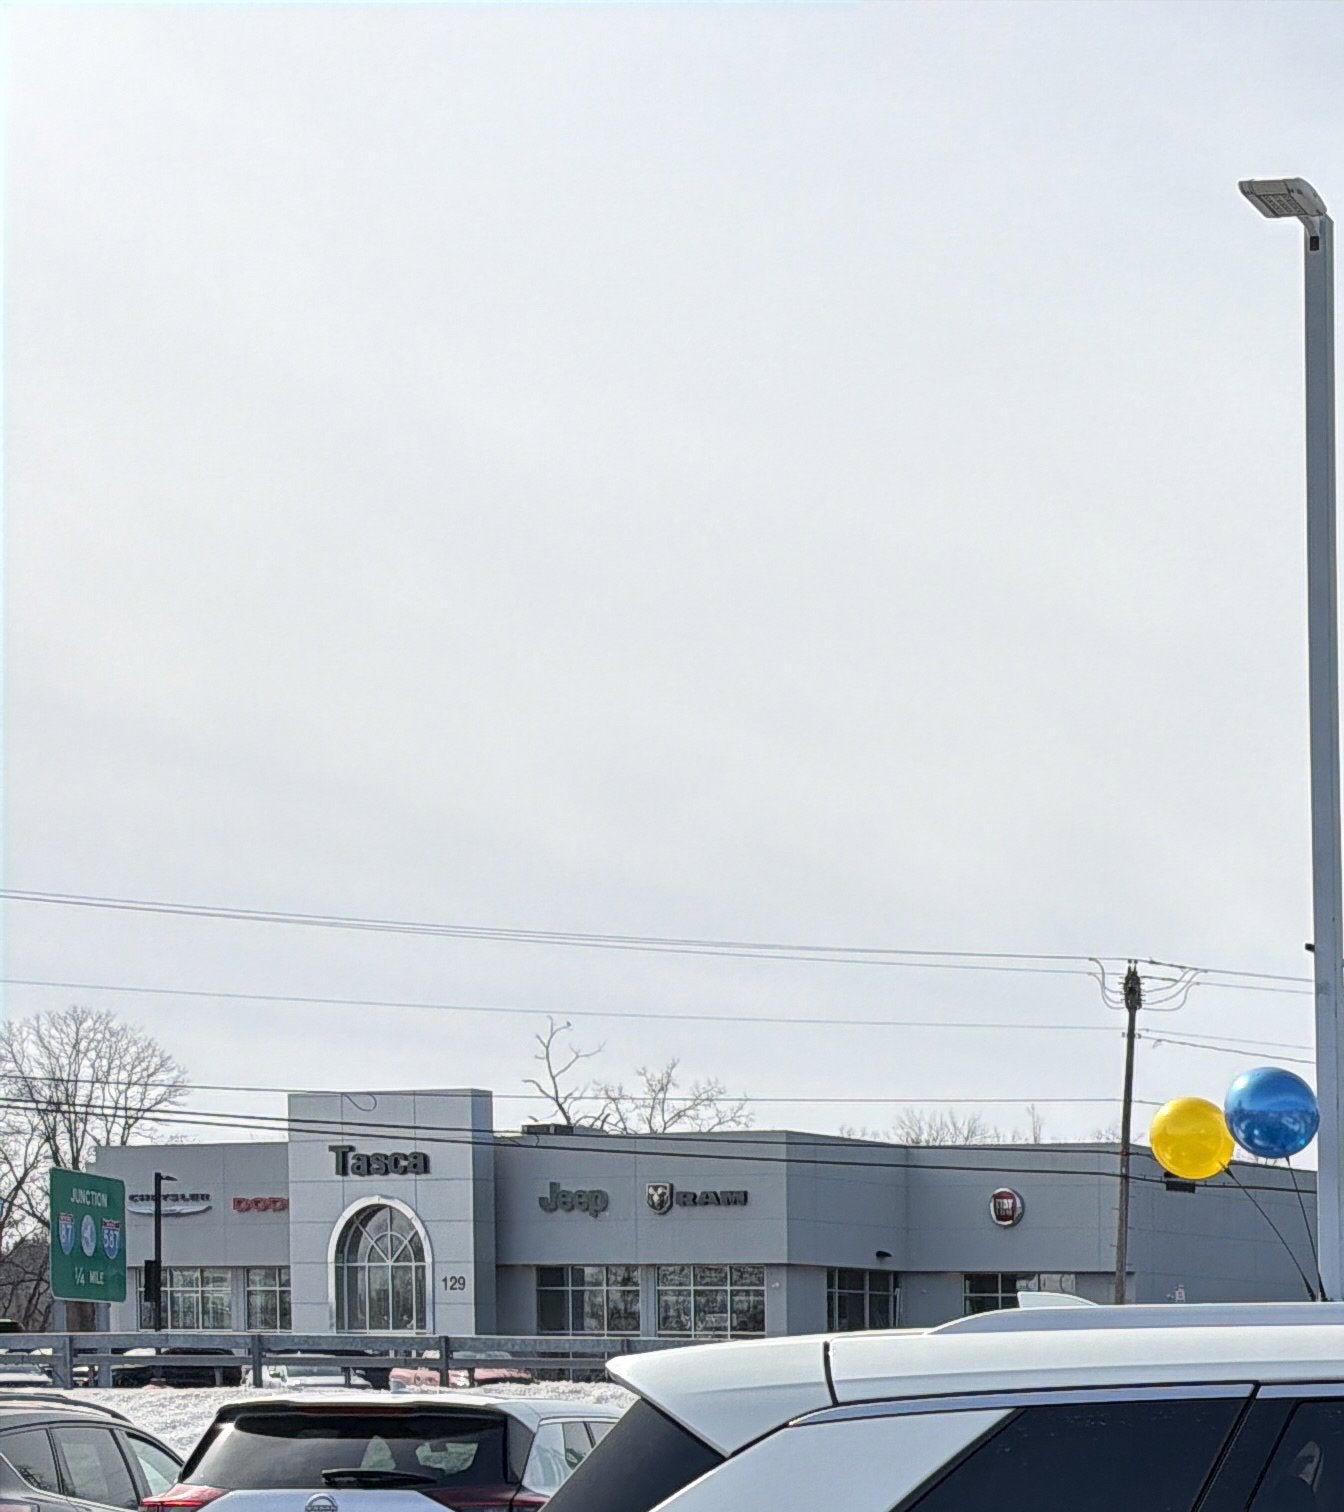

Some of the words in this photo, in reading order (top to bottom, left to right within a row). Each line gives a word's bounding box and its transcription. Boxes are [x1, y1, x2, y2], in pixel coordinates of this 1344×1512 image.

[328, 1144, 431, 1177] Tasca
[70, 1187, 108, 1208] JUNCTION
[538, 1181, 609, 1218] Jeep
[676, 1190, 748, 1207] RAM
[61, 1224, 73, 1243] 87
[103, 1229, 120, 1249] 587
[89, 1270, 104, 1285] MILE
[441, 1275, 466, 1291] 129
